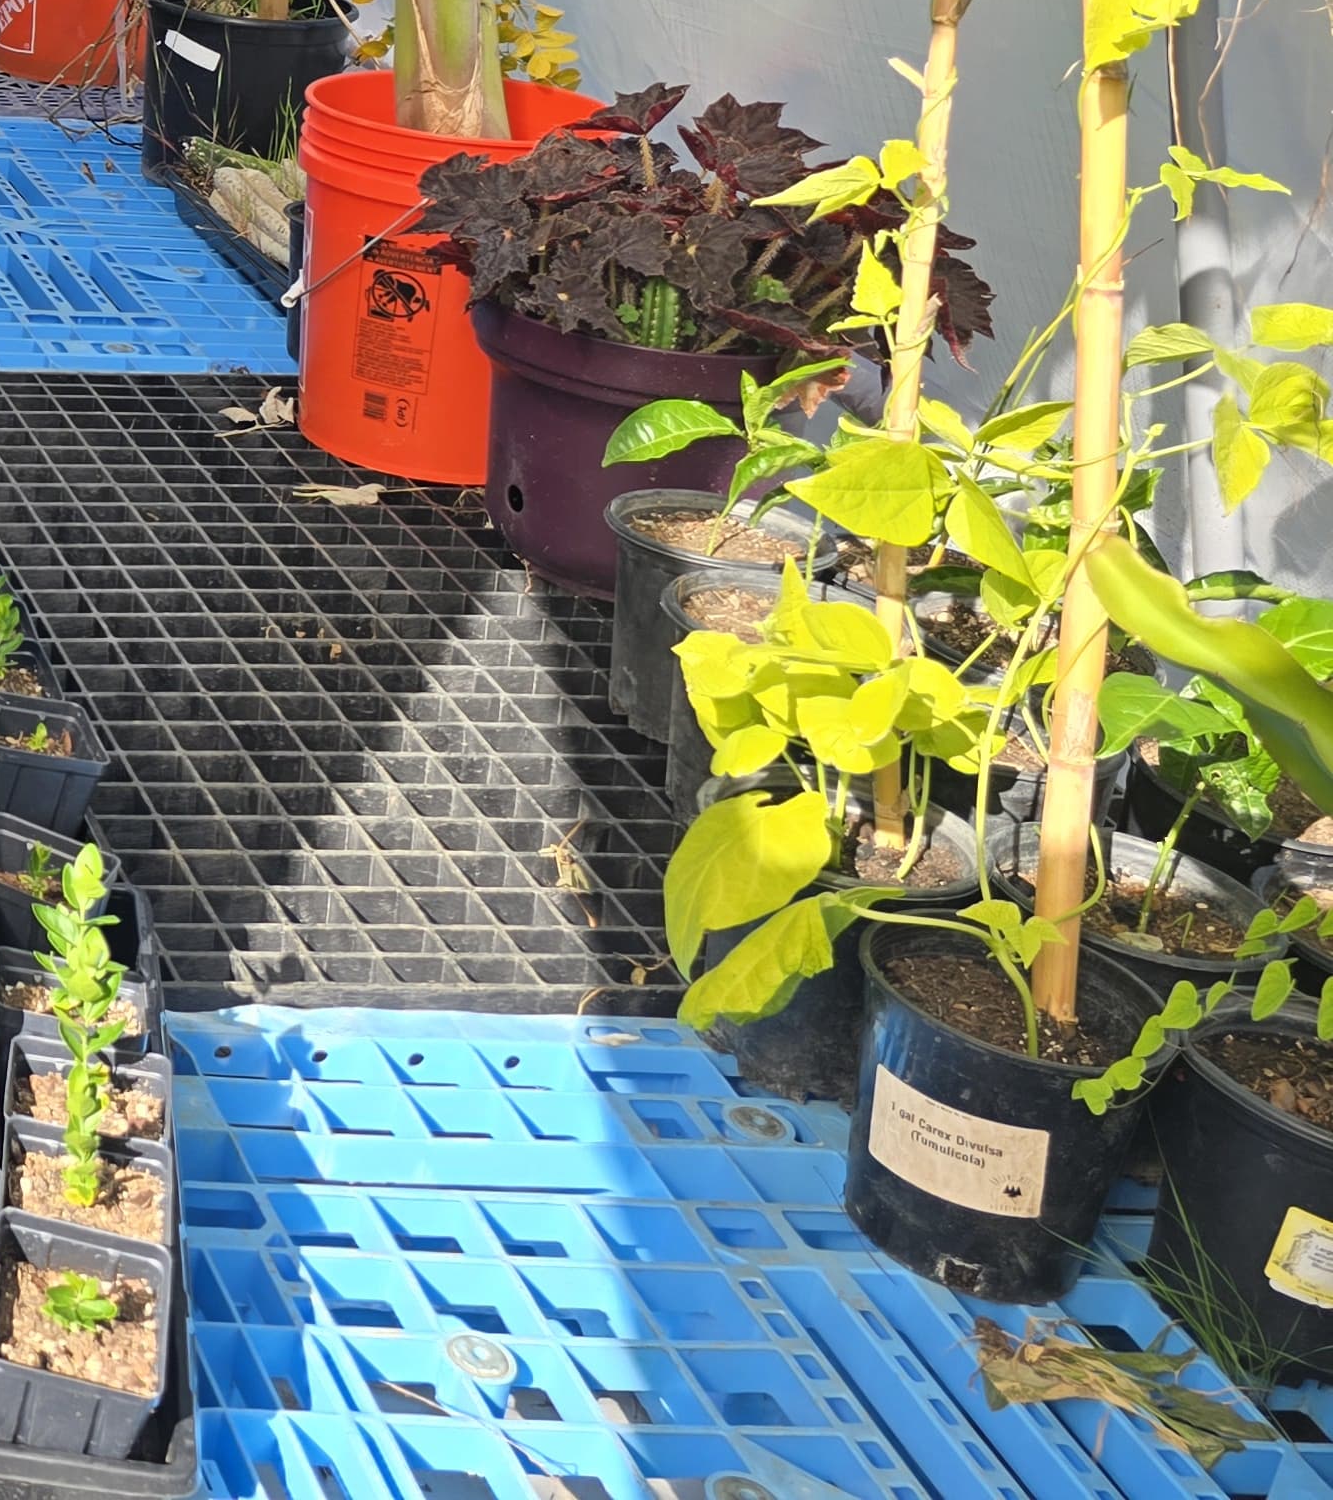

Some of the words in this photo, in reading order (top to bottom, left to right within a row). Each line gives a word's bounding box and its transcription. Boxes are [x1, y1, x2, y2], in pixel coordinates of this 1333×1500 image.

[899, 1108, 915, 1122] gal
[918, 1118, 951, 1141] Carex
[956, 1135, 1004, 1158] Divulsa
